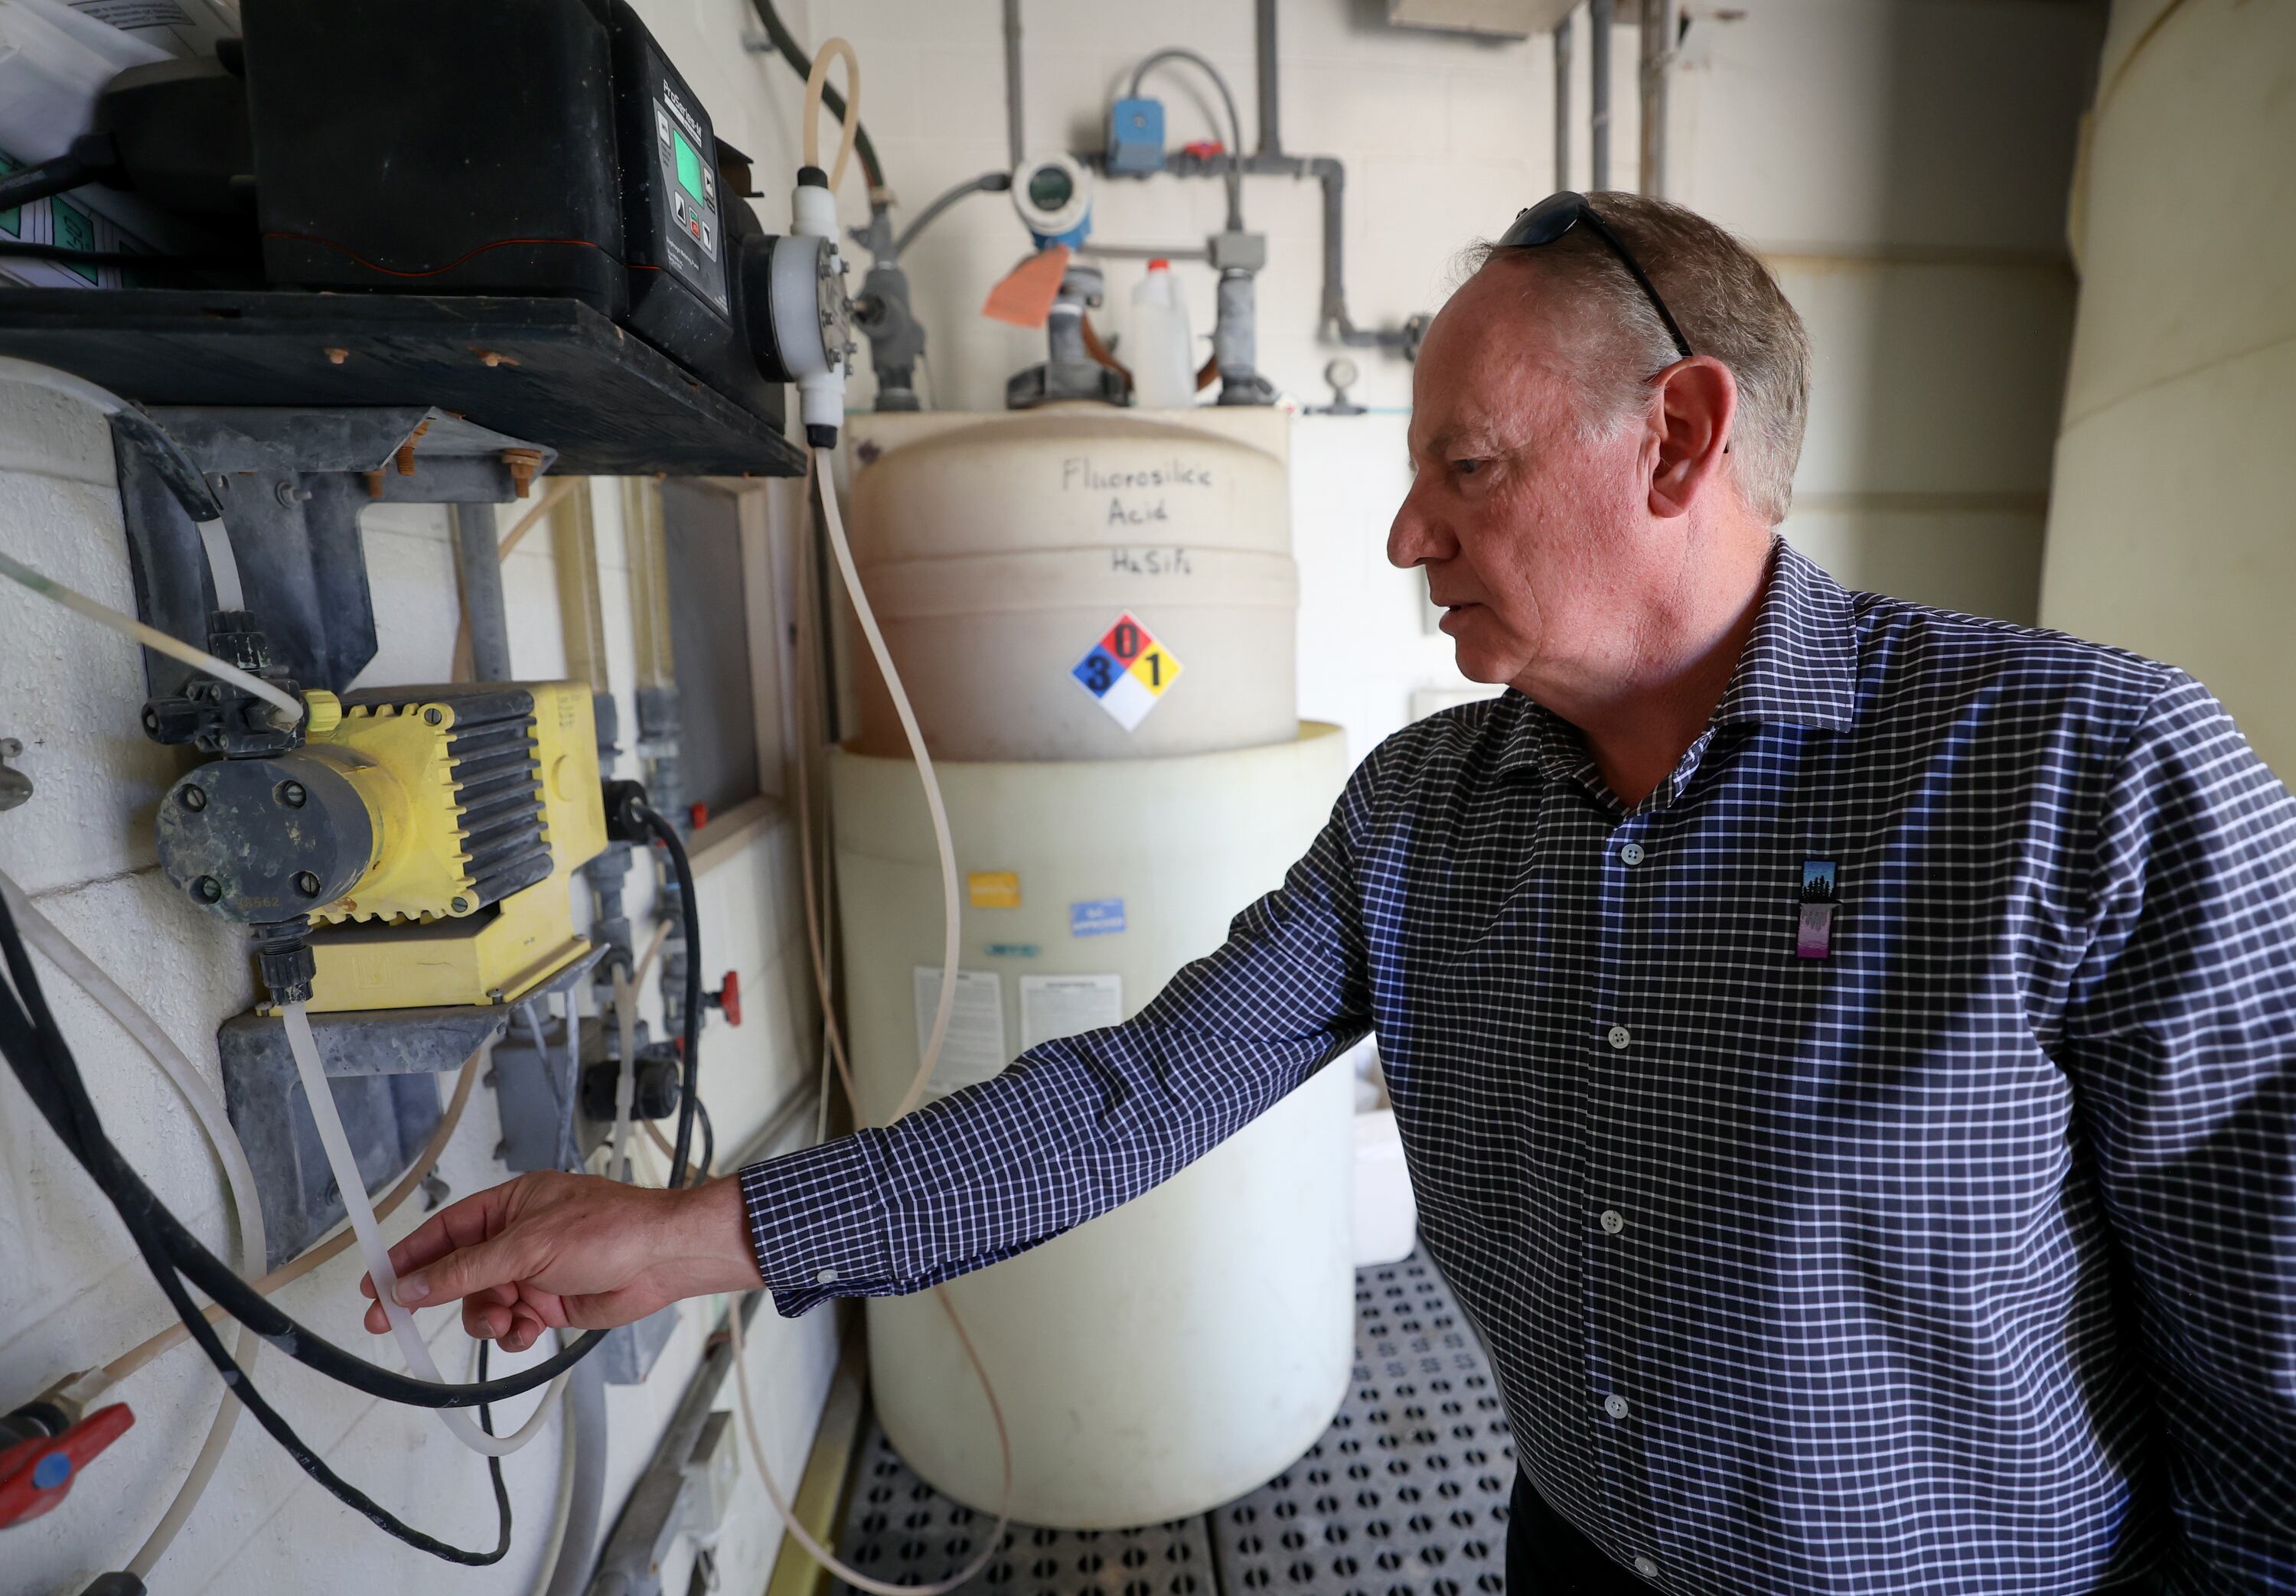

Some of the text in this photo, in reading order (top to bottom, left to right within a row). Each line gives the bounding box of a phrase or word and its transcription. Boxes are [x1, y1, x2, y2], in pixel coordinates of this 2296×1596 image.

[663, 78, 702, 138] ProSeries-M
[1107, 497, 1168, 525] Acid
[1114, 624, 1138, 658] 0
[1087, 655, 1110, 692] 3
[1145, 653, 1159, 686] 1
